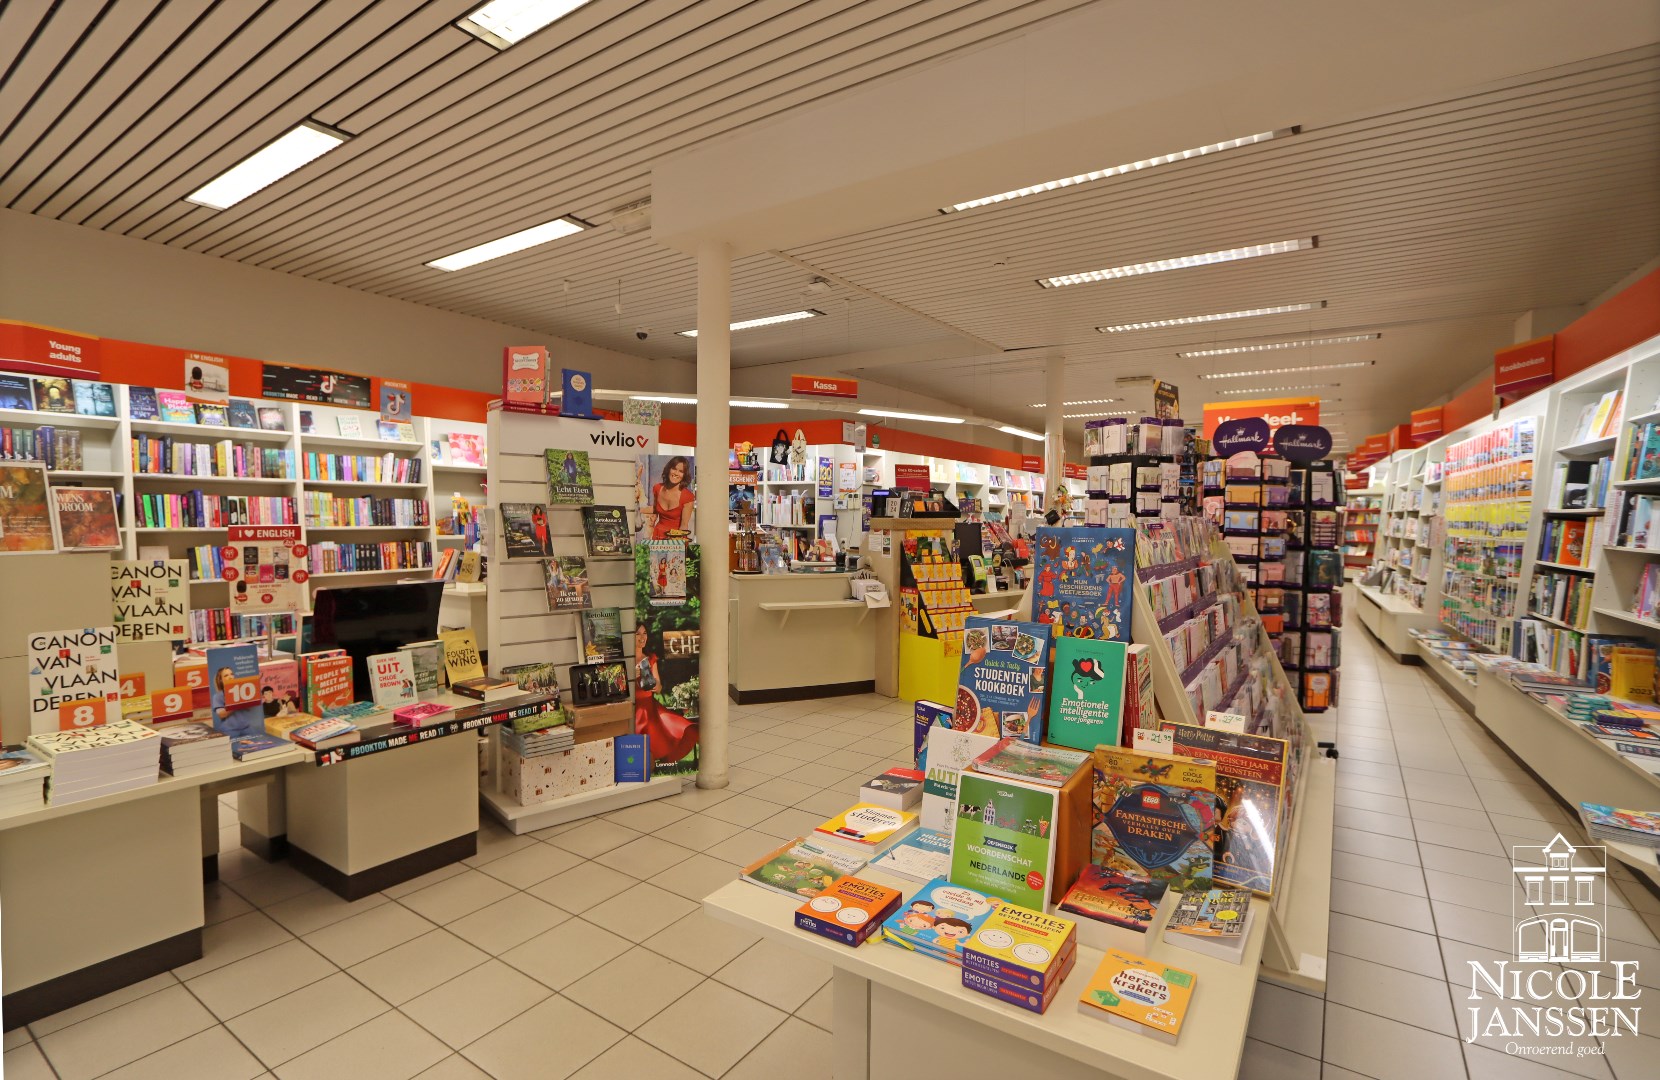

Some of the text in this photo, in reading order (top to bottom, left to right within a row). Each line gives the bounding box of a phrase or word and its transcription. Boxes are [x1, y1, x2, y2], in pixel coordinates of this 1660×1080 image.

[49, 340, 81, 354] Young
[49, 352, 82, 363] adults
[813, 381, 838, 391] Kassa
[590, 431, 635, 447] vivlio
[1219, 431, 1263, 449] Hallmark
[1279, 436, 1325, 450] Hallmark
[238, 529, 295, 538] I ENGLISH
[1059, 589, 1102, 597] WEETJESBOEK
[31, 631, 115, 651] CANON
[447, 648, 475, 659] FOURTH
[448, 655, 477, 667] WING
[36, 654, 81, 670] VAN
[377, 661, 404, 675] UIT,
[984, 659, 1000, 668] Quick
[1006, 661, 1021, 671] Tasty
[44, 669, 117, 689] VLAAN
[186, 670, 202, 688] 5
[315, 665, 350, 682] PEOPLE WE
[974, 666, 1029, 685] STUDENTEN
[120, 679, 137, 697] 4
[317, 681, 349, 697] VACATION
[320, 677, 338, 688] MEET
[380, 680, 401, 688] BROWN
[975, 679, 1025, 697] KOOKBOEK
[228, 682, 256, 703] 10
[163, 693, 183, 712] 9
[1062, 698, 1109, 710] Emotionele
[73, 705, 95, 726] 8
[463, 705, 538, 730] #BOOKTOK MADE ME READ IT
[1060, 706, 1109, 718] intelligentie
[1076, 717, 1104, 725] jongeren
[350, 727, 444, 756] #BOOKTOK MADE ME READ IT
[1178, 728, 1216, 743] Harry Potter
[1194, 751, 1269, 770] EEN MAGISCH JAAR
[1143, 796, 1160, 804] LEGO
[850, 811, 897, 827] studeren
[865, 808, 898, 820] Slimmer
[1115, 810, 1187, 831] FANTASTISCHE
[1122, 820, 1181, 835] VERHALEN OVER
[1127, 826, 1173, 841] DRAKEN
[967, 844, 1033, 867] WOORDENSCHAT
[969, 860, 1026, 882] NEDERLANDS
[842, 881, 886, 897] EMOTIES
[942, 889, 965, 900] voelde
[945, 895, 974, 907] vandaag
[998, 912, 1020, 921] BETER
[1021, 919, 1062, 934] BEGRIJPEN
[1001, 905, 1067, 930] EMOTIES
[965, 952, 1000, 969] EMOTIES
[964, 971, 998, 989] EMOTIES
[1119, 970, 1167, 992] hersen
[1113, 976, 1167, 1001] krakers
